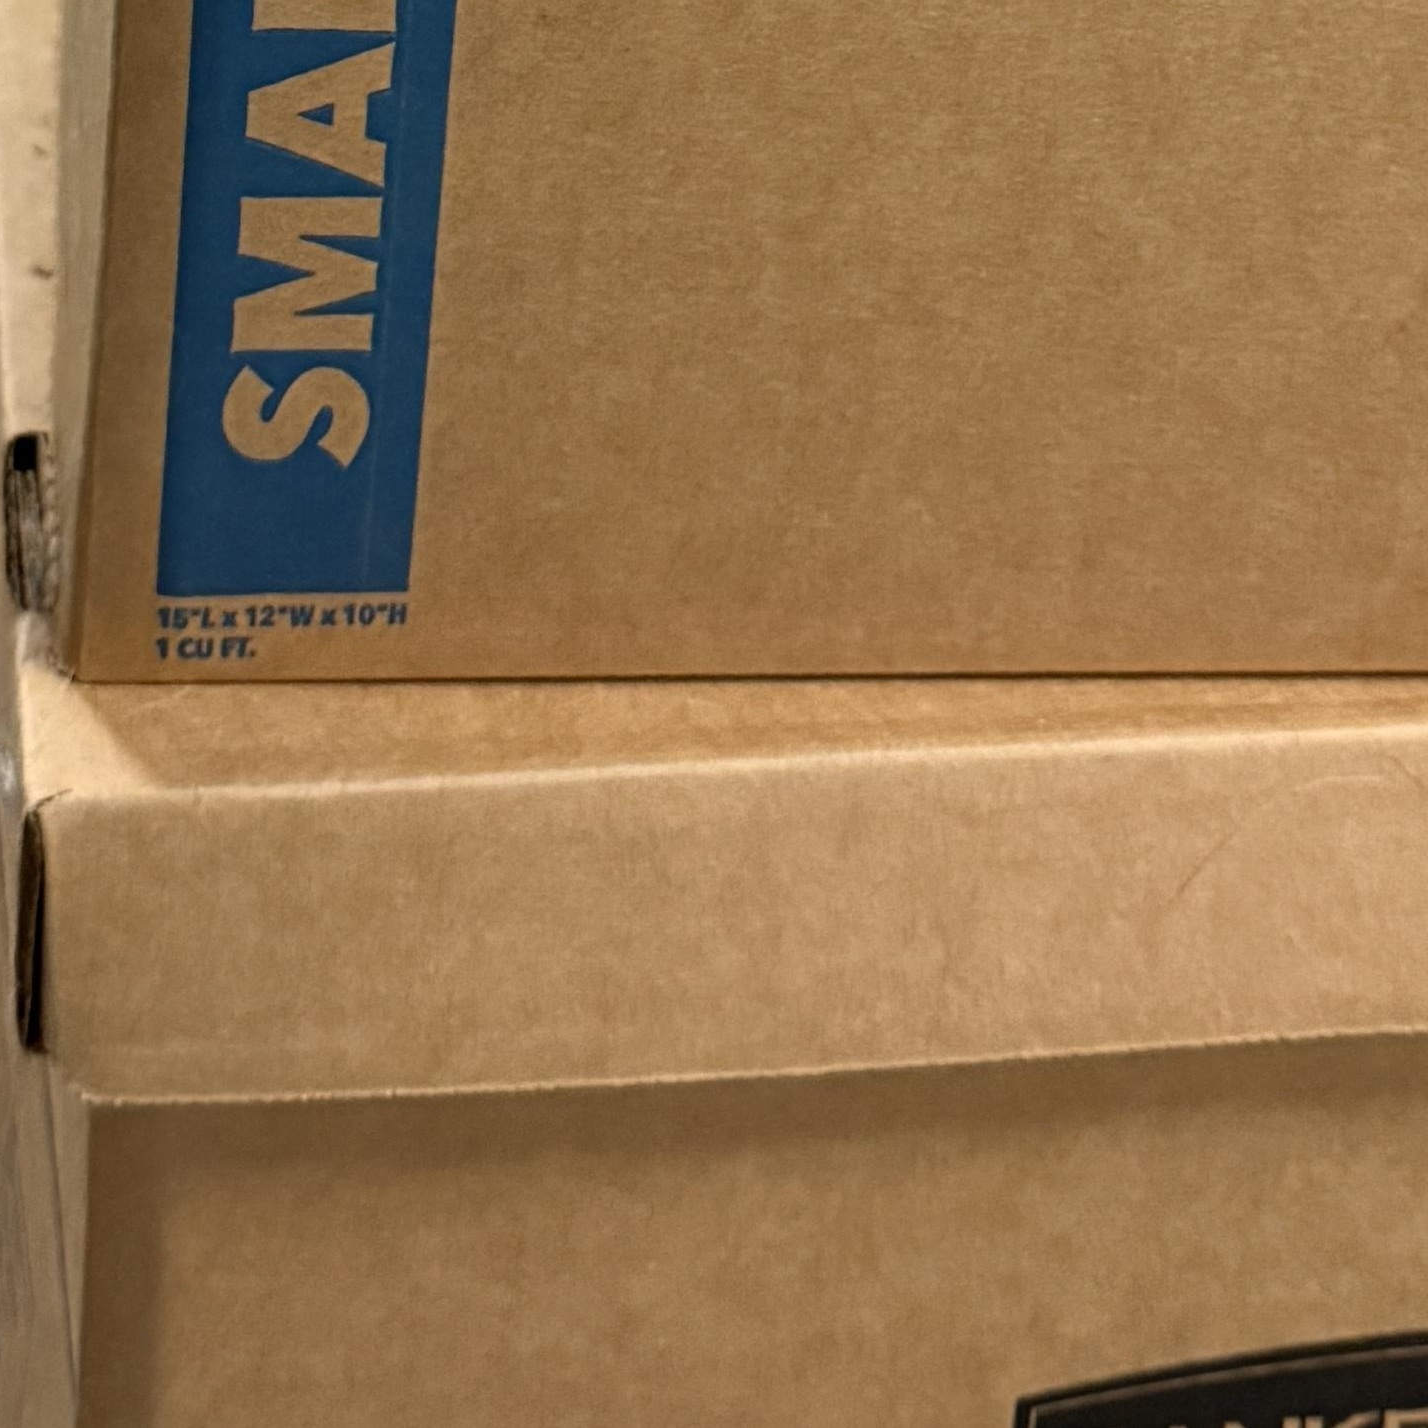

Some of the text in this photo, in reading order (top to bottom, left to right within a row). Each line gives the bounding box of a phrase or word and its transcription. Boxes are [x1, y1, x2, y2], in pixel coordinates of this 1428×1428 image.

[157, 602, 408, 630] 15"L x 12"W x 10"H
[156, 637, 169, 660] 1
